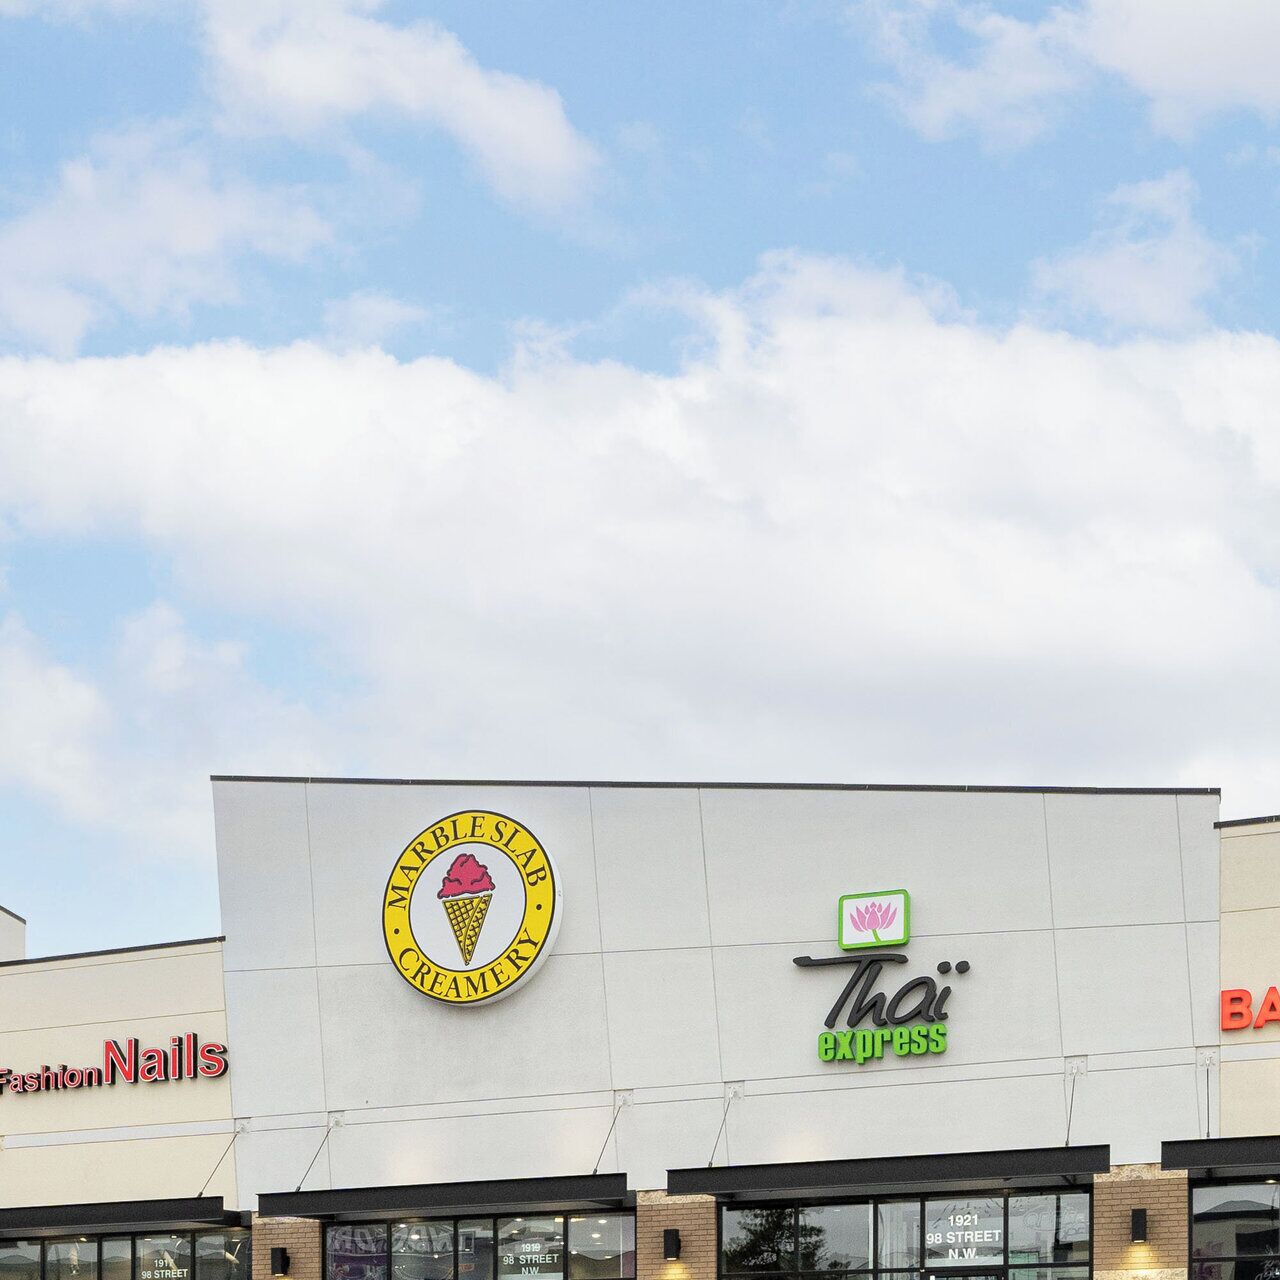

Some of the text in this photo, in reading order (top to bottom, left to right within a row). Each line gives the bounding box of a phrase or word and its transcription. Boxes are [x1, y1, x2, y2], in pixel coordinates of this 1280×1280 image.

[387, 815, 547, 911] MARBLE SLAB
[399, 927, 540, 999] CREAMERY
[817, 1023, 948, 1065] express
[103, 1031, 229, 1085] Nails
[948, 1214, 980, 1227] 1921
[926, 1229, 1002, 1245] 98 STREET
[521, 1243, 541, 1252] 1919
[503, 1253, 559, 1265] 98 STREET
[141, 1268, 189, 1279] 98 STREET
